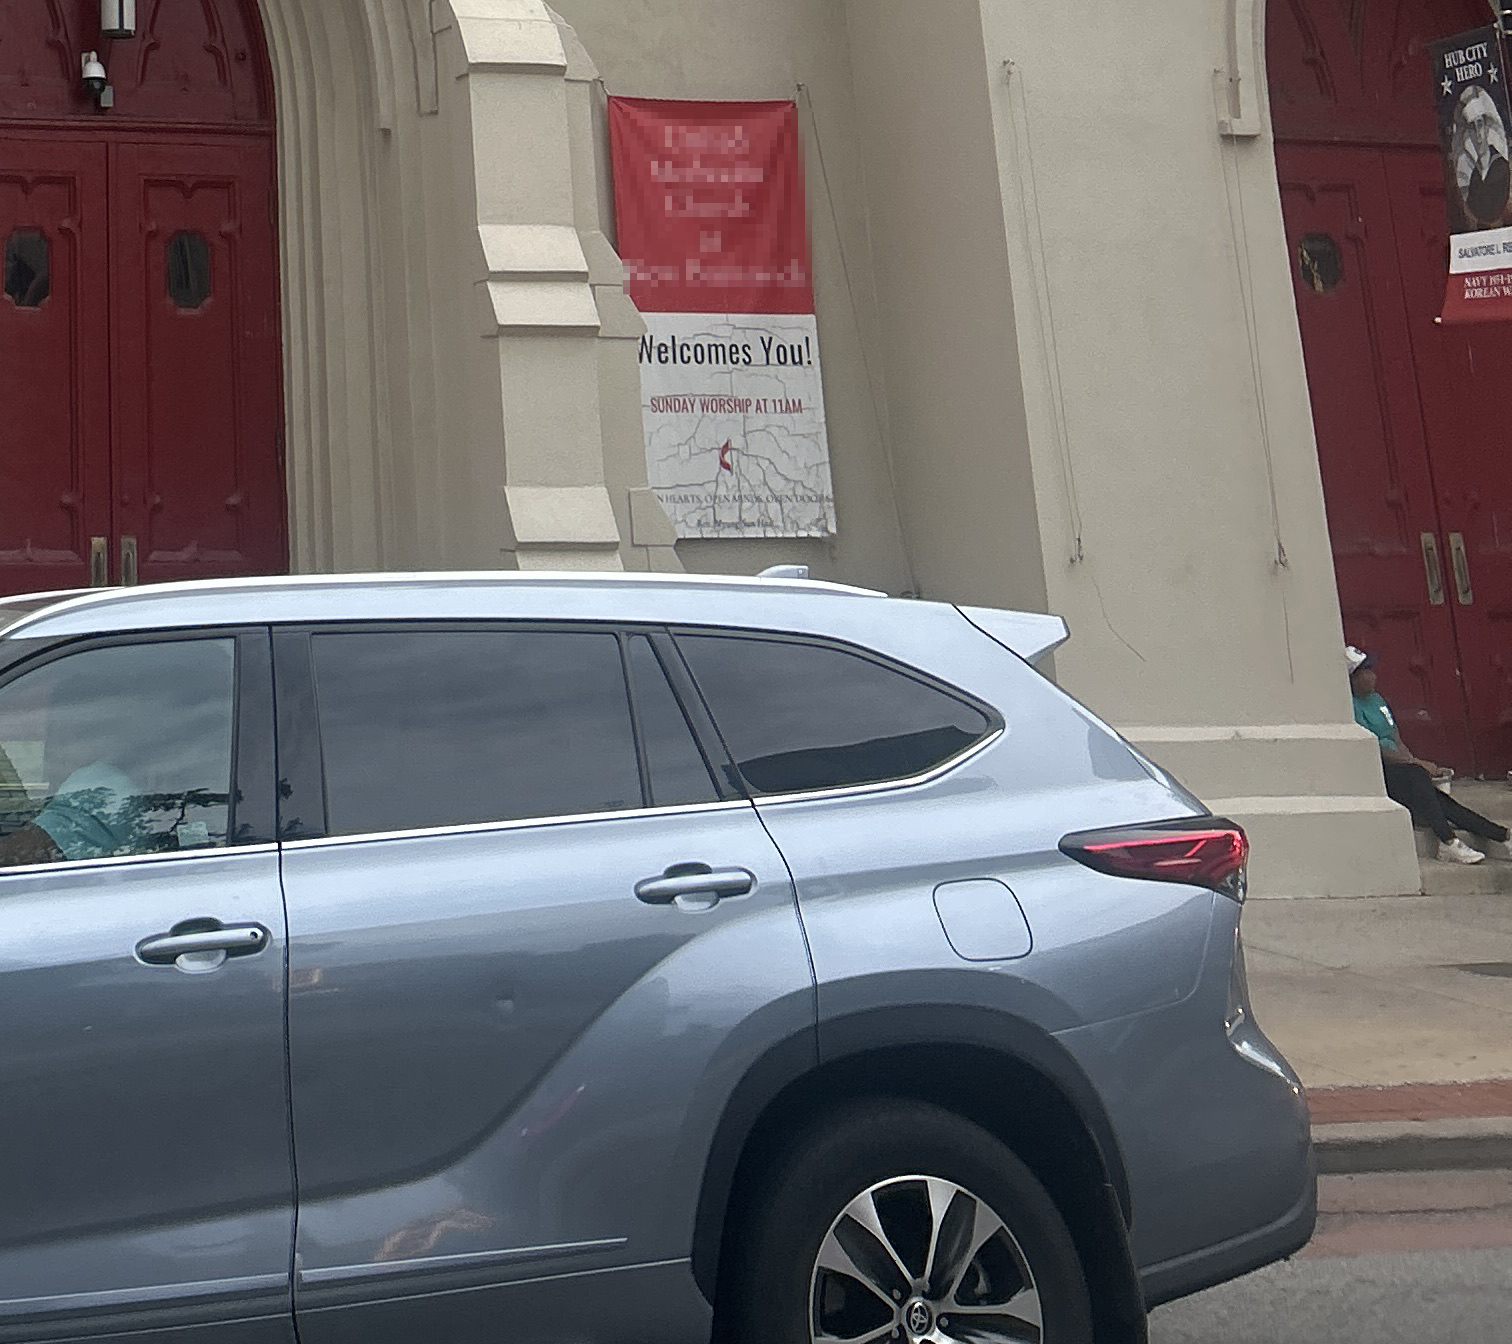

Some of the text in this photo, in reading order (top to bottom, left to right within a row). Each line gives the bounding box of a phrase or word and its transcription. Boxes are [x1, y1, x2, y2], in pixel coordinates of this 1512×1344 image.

[1444, 42, 1488, 69] HUB CITY
[1455, 62, 1483, 82] HERO
[759, 336, 812, 365] You!
[650, 397, 803, 413] SUNDAY WORSHIP AT 11AM
